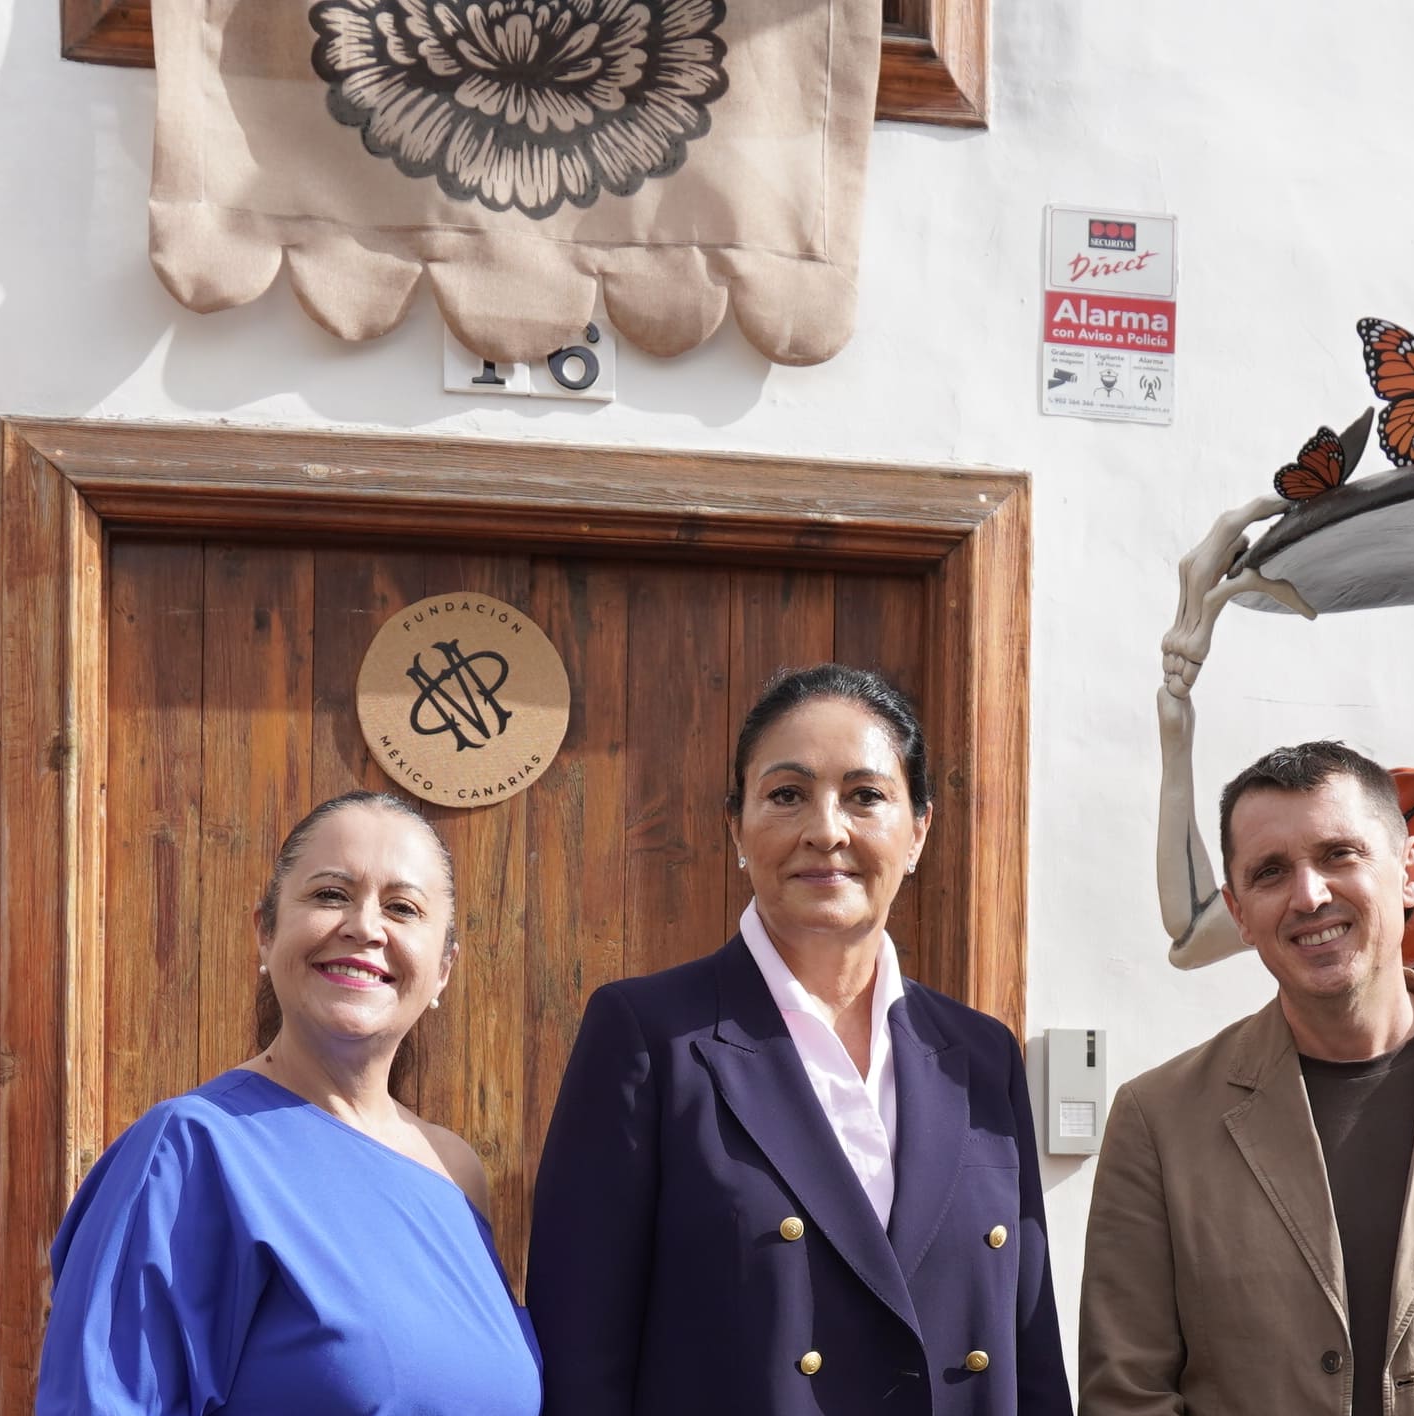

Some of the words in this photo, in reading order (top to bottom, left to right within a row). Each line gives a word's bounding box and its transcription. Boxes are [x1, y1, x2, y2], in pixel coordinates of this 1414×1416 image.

[1090, 237, 1134, 248] SECURITAS
[1068, 250, 1160, 282] Direct
[1053, 299, 1169, 332] Alarma
[1052, 327, 1075, 339] con
[1078, 329, 1113, 343] Aviso
[1116, 333, 1124, 344] a
[1127, 332, 1168, 348] Policía
[1138, 357, 1164, 365] Alarma
[403, 602, 522, 633] FUNDACIÓN
[380, 735, 433, 790] MÉXICO
[458, 754, 541, 799] CANARIAS
